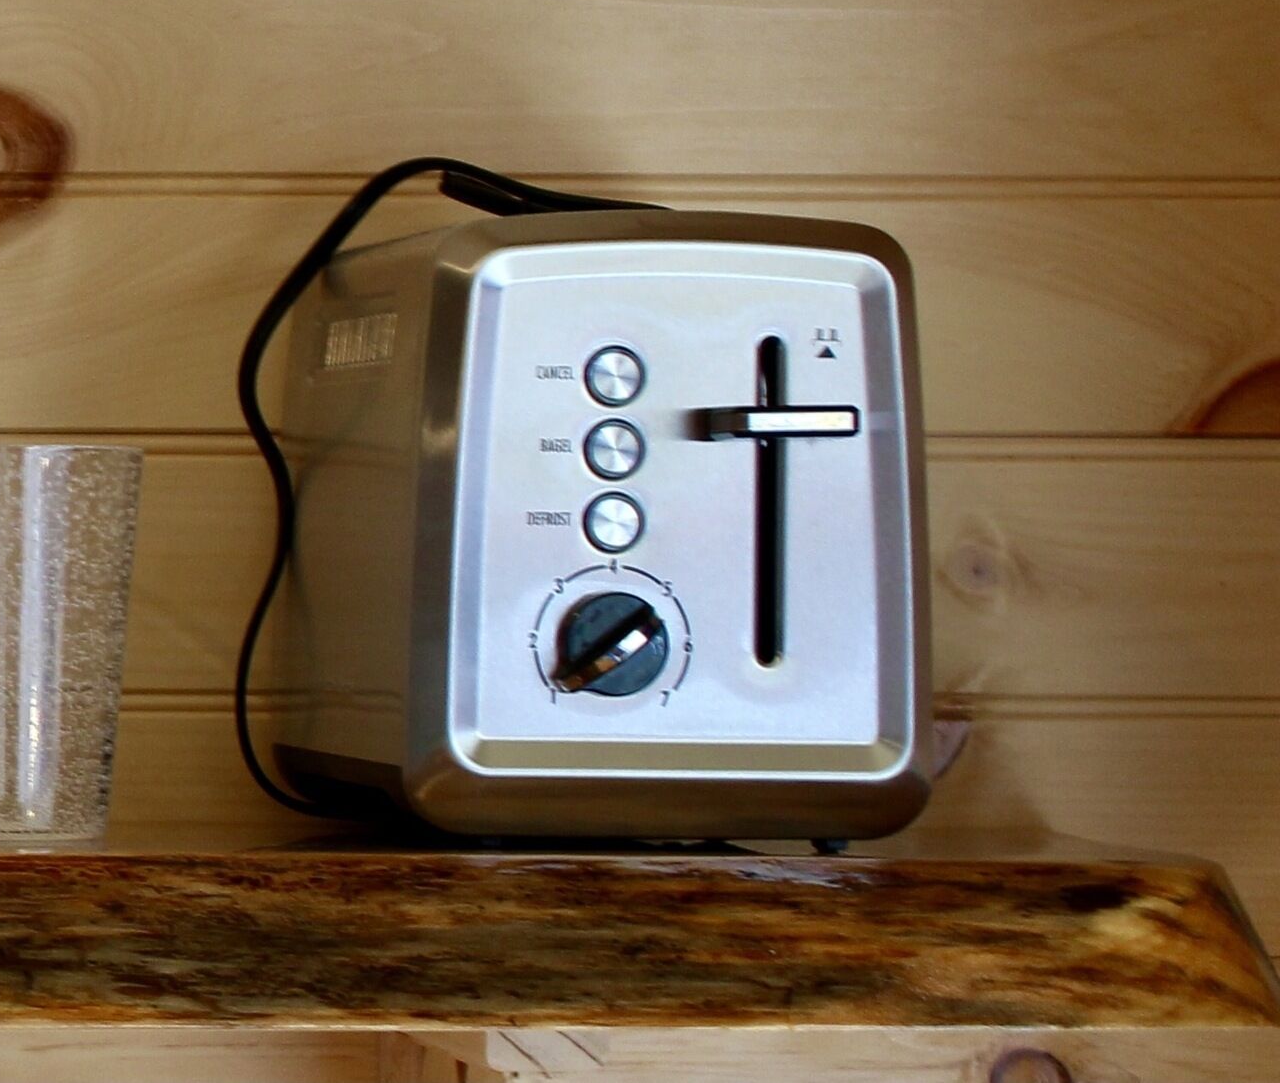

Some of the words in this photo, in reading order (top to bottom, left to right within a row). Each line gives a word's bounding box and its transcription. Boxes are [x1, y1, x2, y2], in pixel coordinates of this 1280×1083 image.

[536, 366, 574, 380] CANCEL
[539, 438, 572, 453] BAGEL
[527, 511, 571, 526] DEFROST
[609, 558, 618, 574] 4
[553, 578, 565, 594] 3
[661, 580, 673, 597] 5
[528, 632, 538, 649] 2
[683, 638, 693, 653] 6
[659, 690, 671, 707] 7
